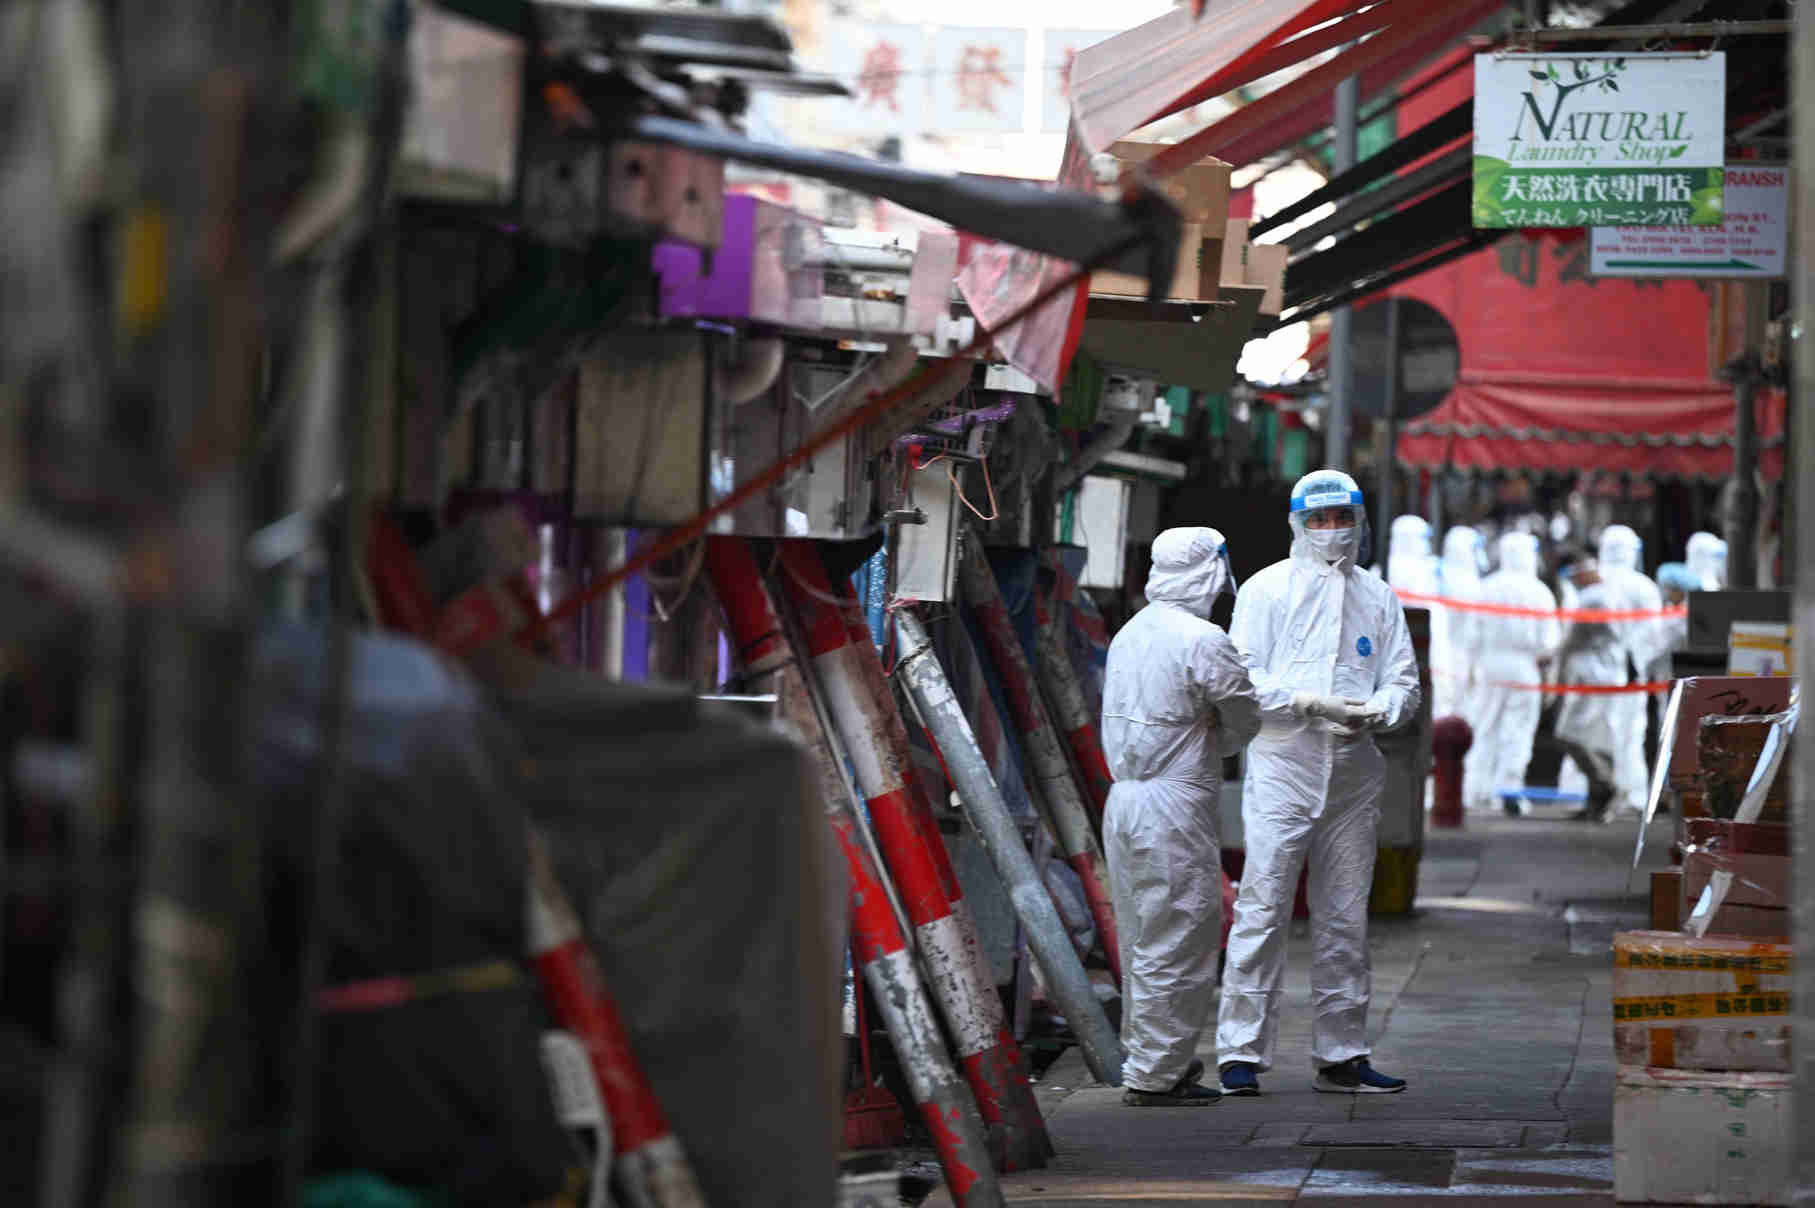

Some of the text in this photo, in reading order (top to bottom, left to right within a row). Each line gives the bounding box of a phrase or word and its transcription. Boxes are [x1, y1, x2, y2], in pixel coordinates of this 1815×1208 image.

[1508, 88, 1693, 142] NATURAL
[1507, 141, 1673, 166] Laundry Shop
